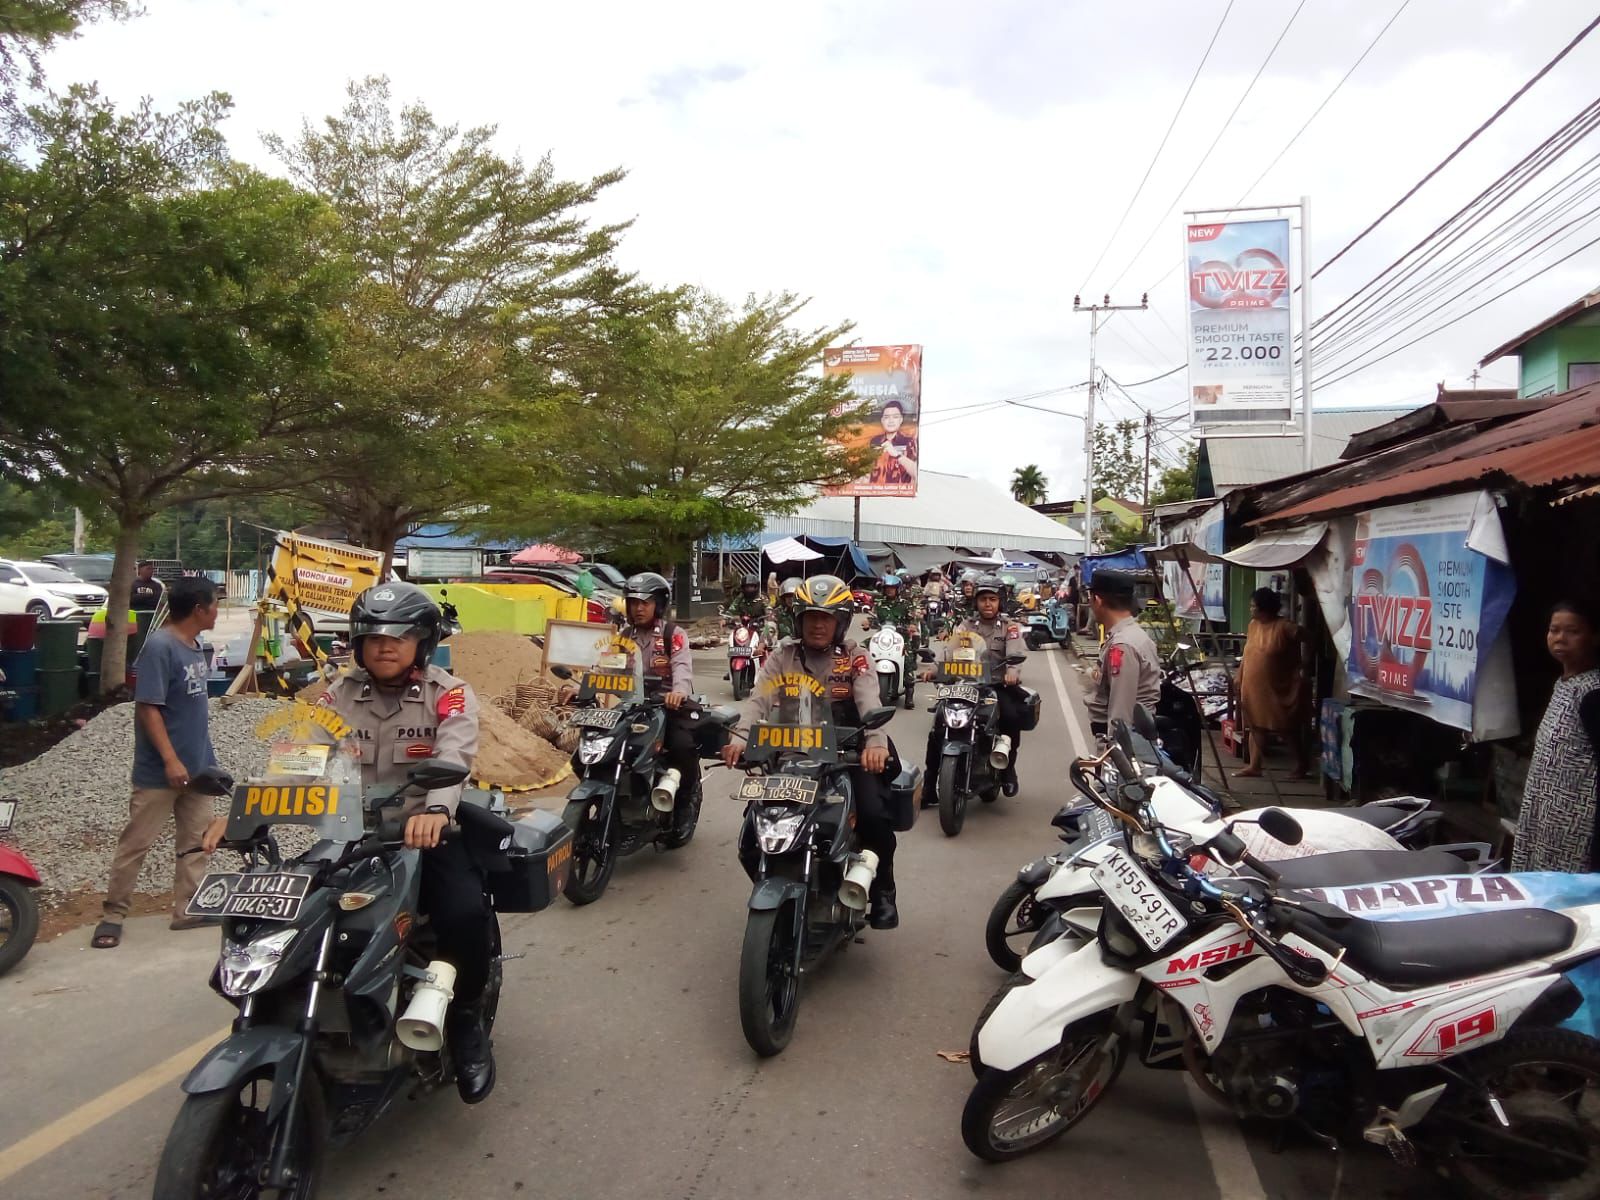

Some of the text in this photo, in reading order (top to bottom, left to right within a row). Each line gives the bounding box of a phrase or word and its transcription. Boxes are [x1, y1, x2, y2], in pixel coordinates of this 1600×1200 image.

[1189, 228, 1216, 238] NEW
[1193, 268, 1289, 293] TWIZZ
[1229, 299, 1265, 307] PRIME
[1194, 323, 1249, 333] PREMIUM
[1194, 332, 1285, 344] SMOOTH TASTE
[298, 569, 349, 586] MOHON MAAF
[327, 596, 346, 606] PARIT
[1357, 594, 1433, 653] TWIZZ
[944, 662, 983, 676] POLISI
[1380, 669, 1408, 687] RIME
[587, 674, 634, 692] POLISI
[785, 672, 826, 697] CENTRE
[397, 727, 438, 738] POLRI
[758, 726, 823, 749] POLISI
[245, 785, 340, 817] POLISI
[768, 788, 807, 801] 1045-31
[1106, 852, 1179, 935] KH5549TR
[1343, 875, 1527, 912] NAPZA
[229, 896, 292, 917] 1046-31
[1437, 1008, 1497, 1052] 19
